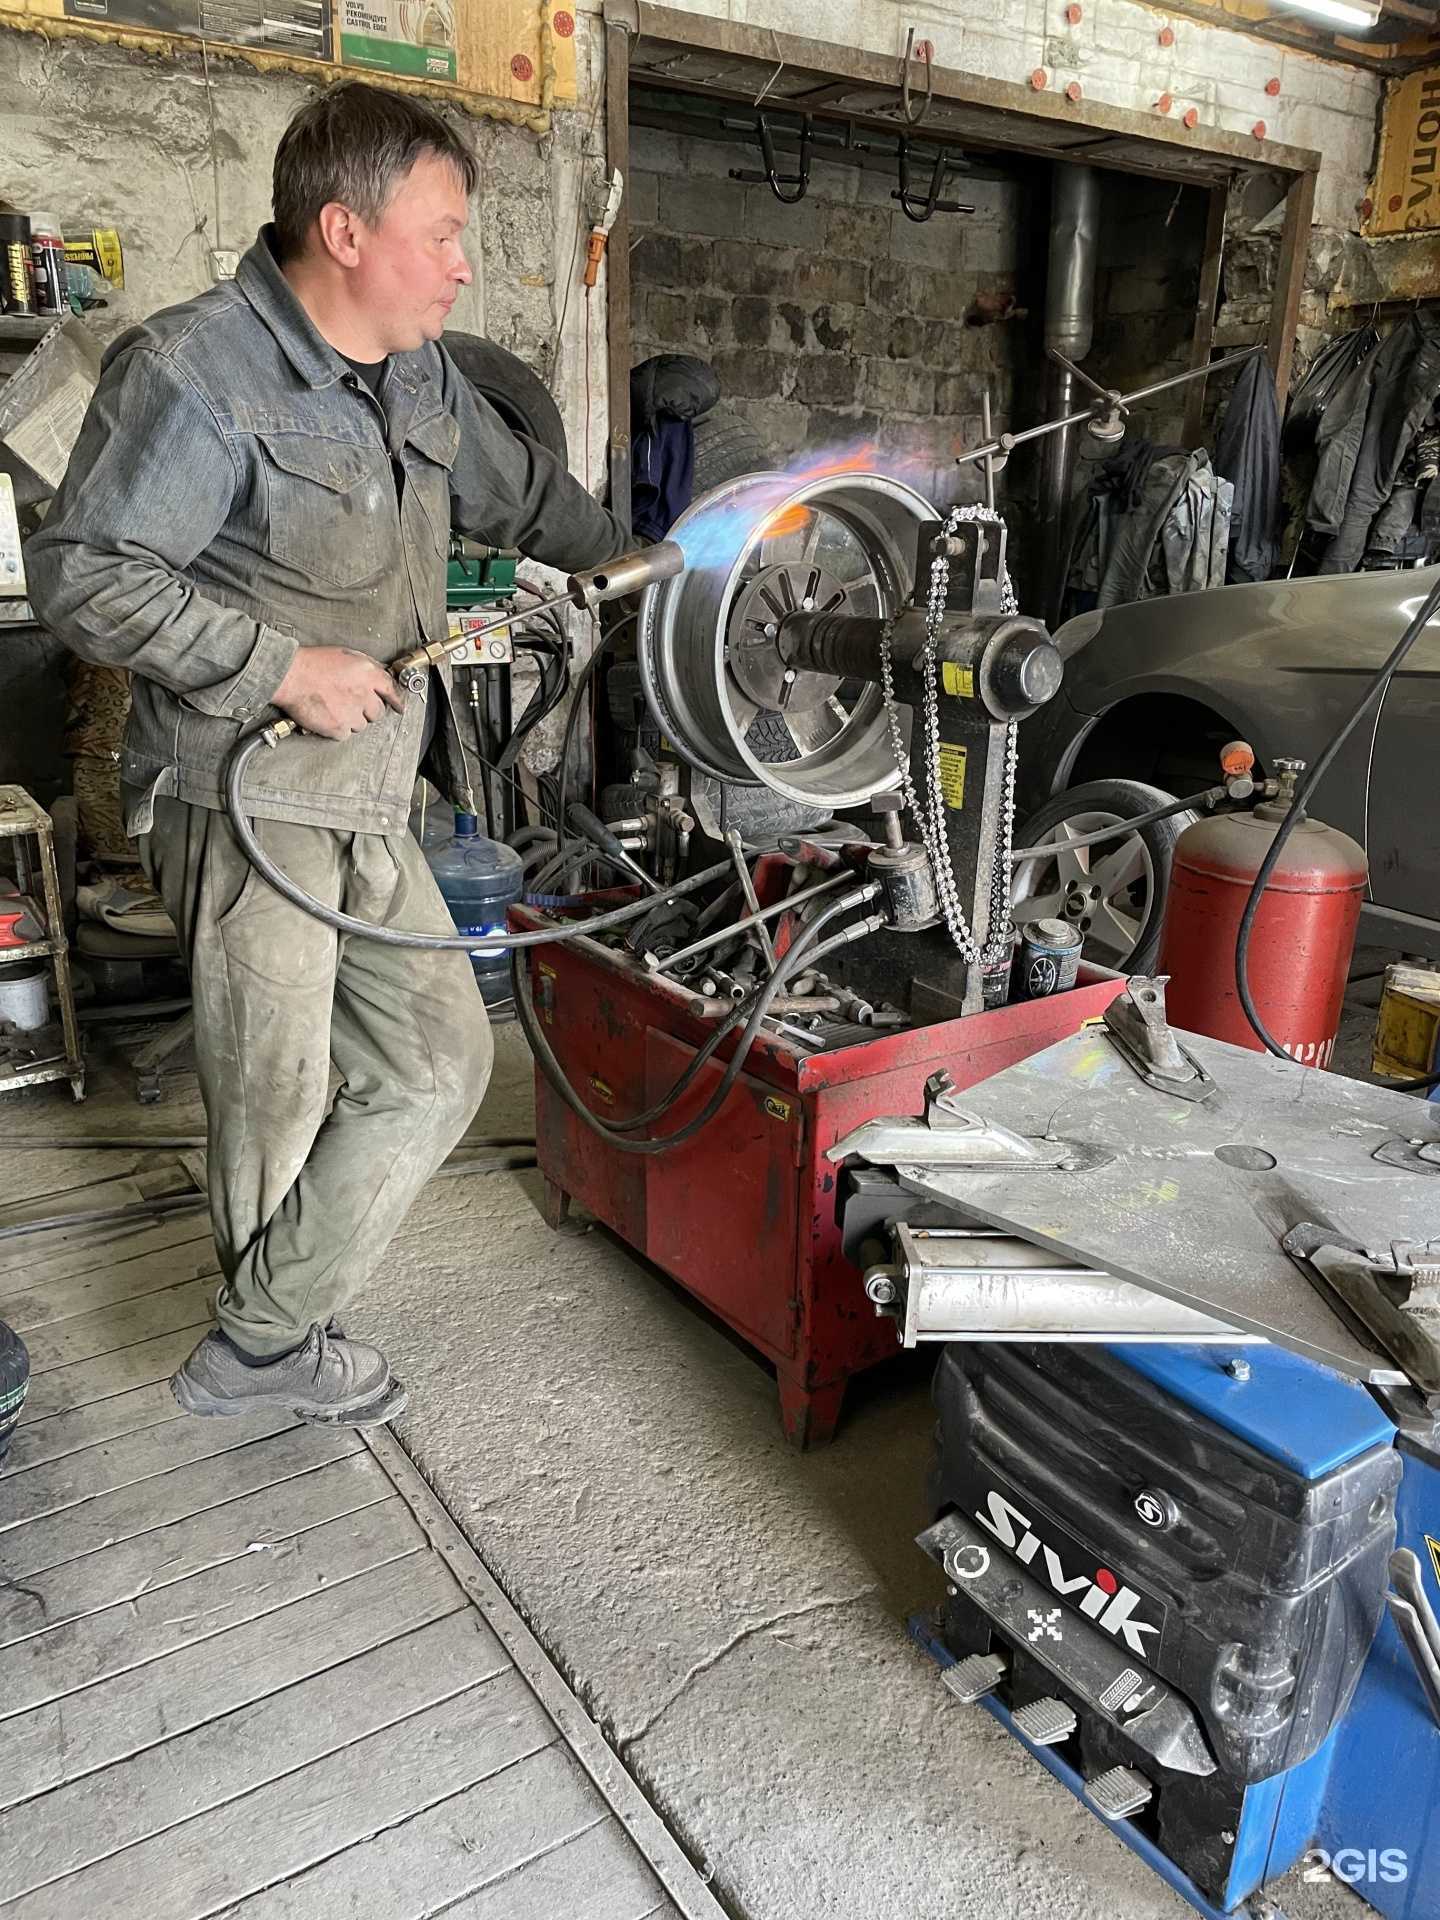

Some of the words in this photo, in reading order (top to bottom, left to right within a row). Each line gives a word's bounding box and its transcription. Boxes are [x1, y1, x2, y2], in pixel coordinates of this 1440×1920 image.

[345, 1, 364, 10] VOLVO
[346, 9, 387, 23] РЕКОМЕНДУЕТ
[346, 18, 371, 29] CASTROL
[373, 23, 387, 31] EDGE
[8, 241, 27, 303] MOBIHEL
